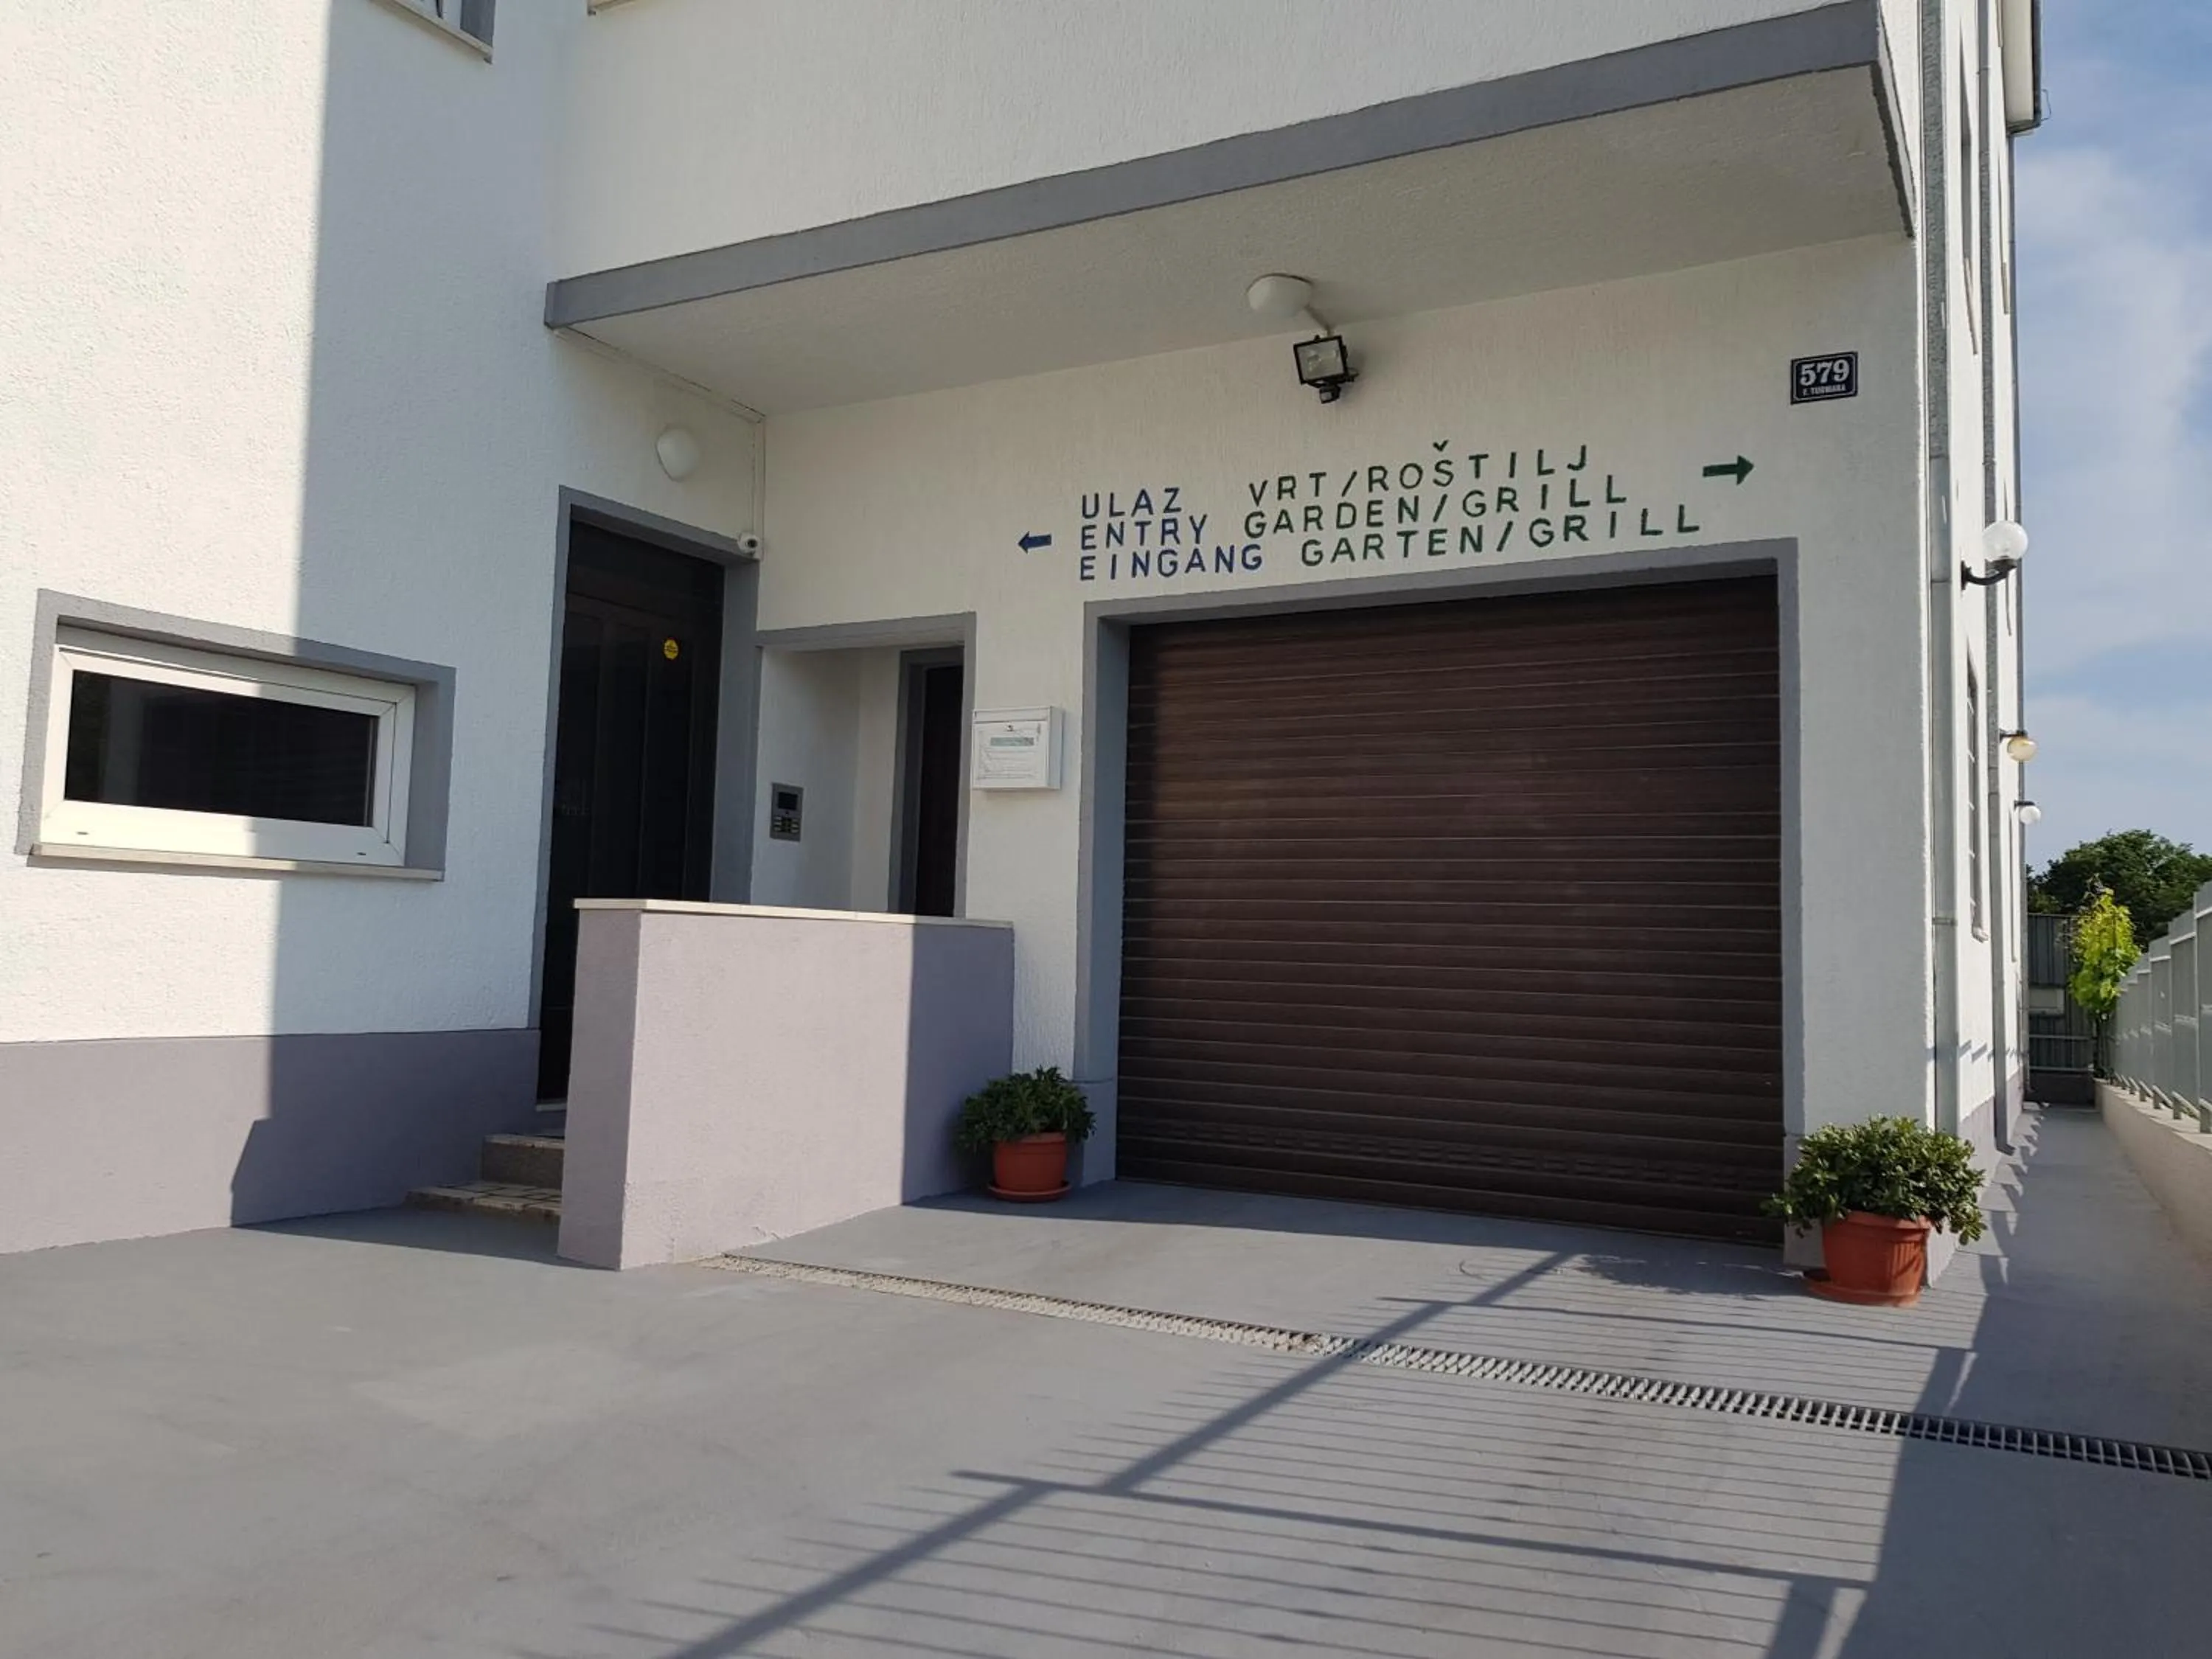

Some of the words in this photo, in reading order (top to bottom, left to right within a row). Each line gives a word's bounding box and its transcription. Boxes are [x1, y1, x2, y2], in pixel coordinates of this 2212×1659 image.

[1800, 359, 1850, 386] 579
[1248, 440, 1587, 507] VRT/ROŠTILJ
[1082, 487, 1181, 519] ULAZ
[1244, 475, 1627, 538] GARDEN/GRILL
[1081, 514, 1208, 550] ENTRY
[1301, 504, 1700, 566] GARTEN/GRILL
[1080, 544, 1262, 581] EINGANG
